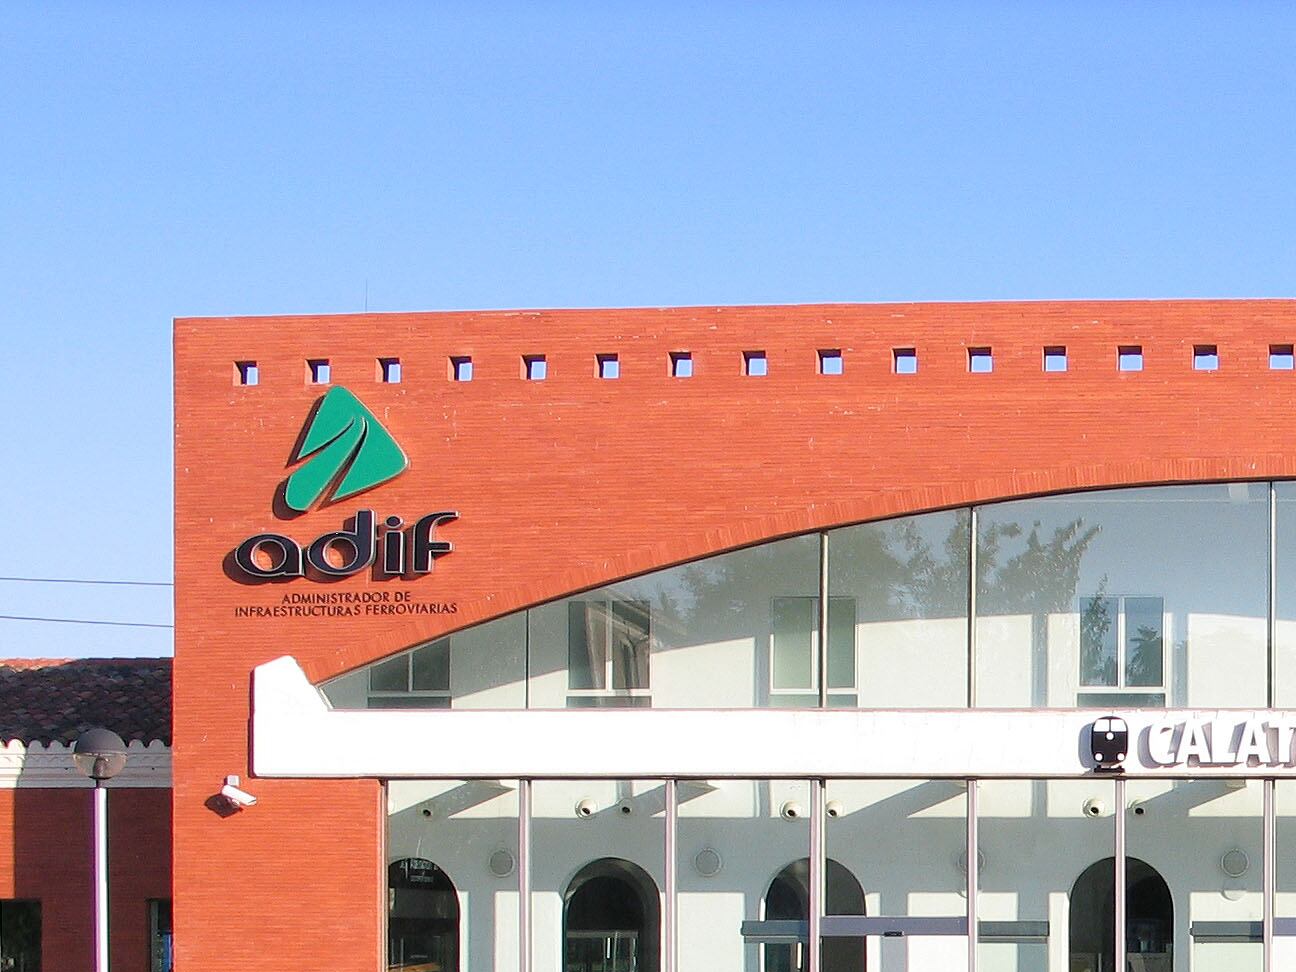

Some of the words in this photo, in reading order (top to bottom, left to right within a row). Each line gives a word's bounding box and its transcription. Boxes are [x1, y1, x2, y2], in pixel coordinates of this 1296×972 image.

[234, 508, 461, 577] adif
[281, 592, 390, 605] ADMINISTRADOR
[394, 591, 411, 602] DE
[234, 605, 361, 618] INFRAESTRUCTURAS
[365, 602, 458, 616] FERROVIARIAS
